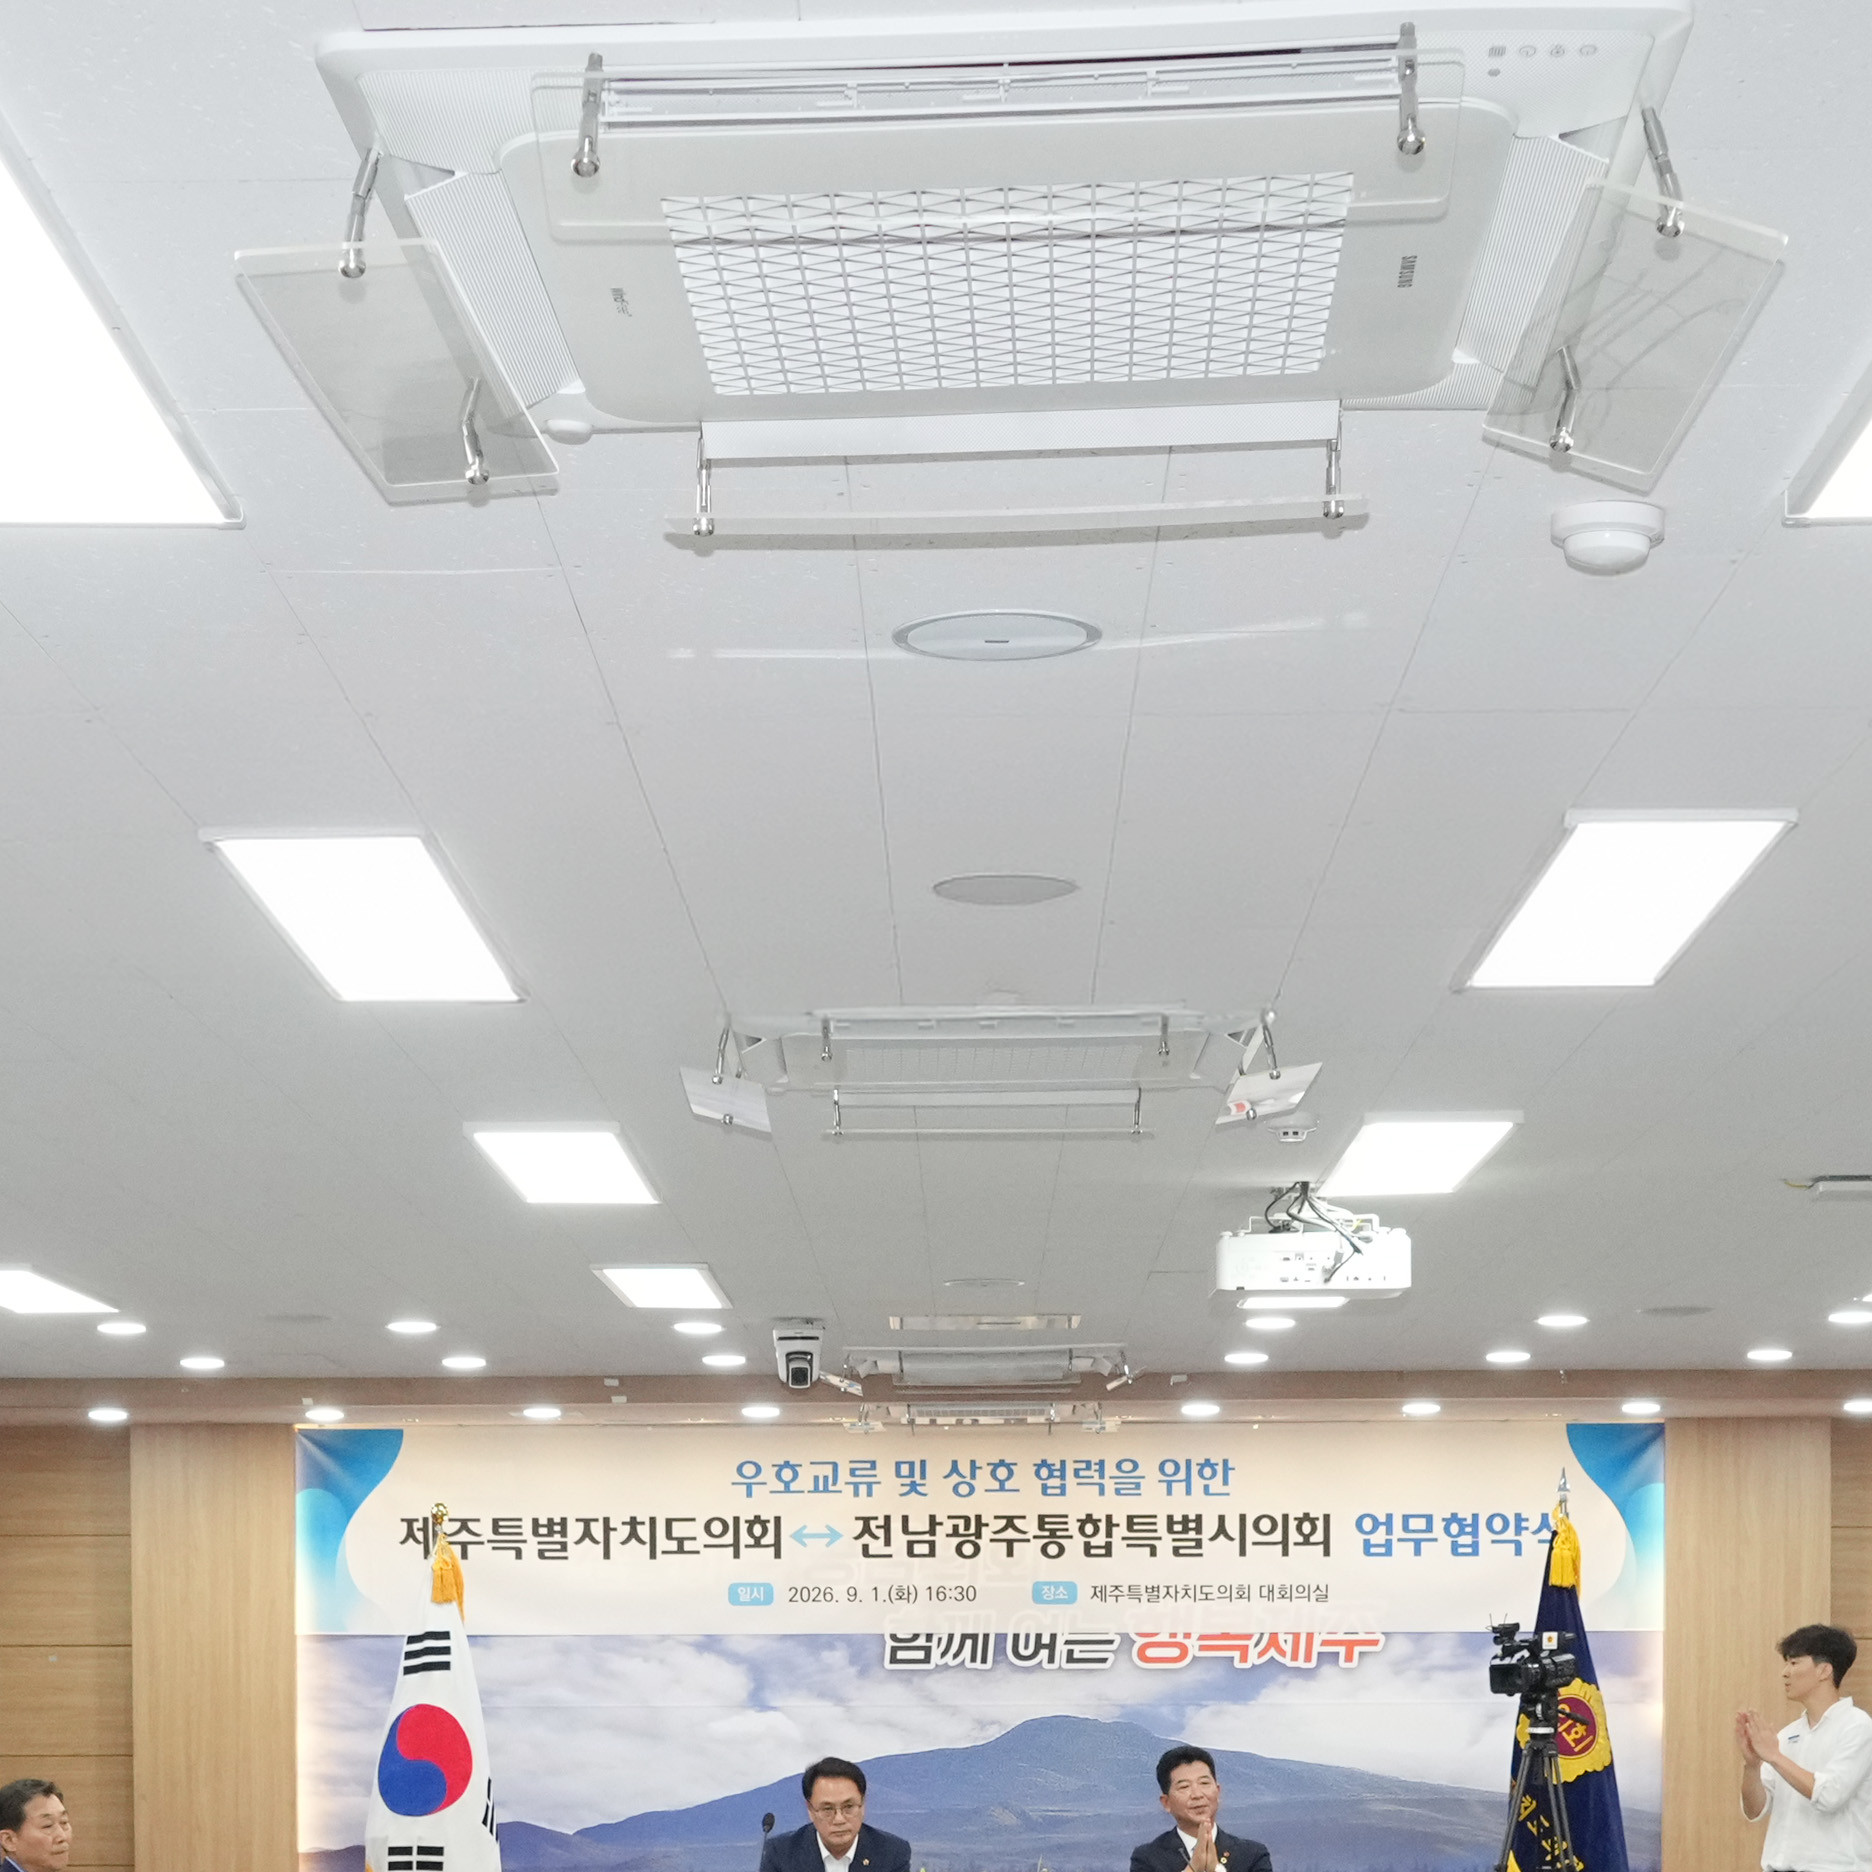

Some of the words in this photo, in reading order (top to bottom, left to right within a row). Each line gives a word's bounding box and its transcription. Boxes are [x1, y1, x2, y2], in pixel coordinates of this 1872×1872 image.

[1397, 255, 1418, 288] SAMSUNG
[731, 1459, 882, 1498] 우호교류
[894, 1459, 928, 1497] 및
[943, 1458, 1020, 1498] 상호
[1032, 1458, 1146, 1497] 협력을
[1158, 1458, 1236, 1497] 위한
[399, 1514, 782, 1561] 제주특별자치도의회
[852, 1511, 1331, 1560] 전남광주통합특별시의회
[737, 1586, 765, 1602] 일시
[788, 1586, 839, 1603] 2026.
[846, 1586, 863, 1603] 9.
[926, 1584, 977, 1603] 16:30
[1041, 1585, 1069, 1601] 장소
[1090, 1583, 1251, 1604] 제주특별자치도의회
[1258, 1583, 1329, 1603] 대회의실
